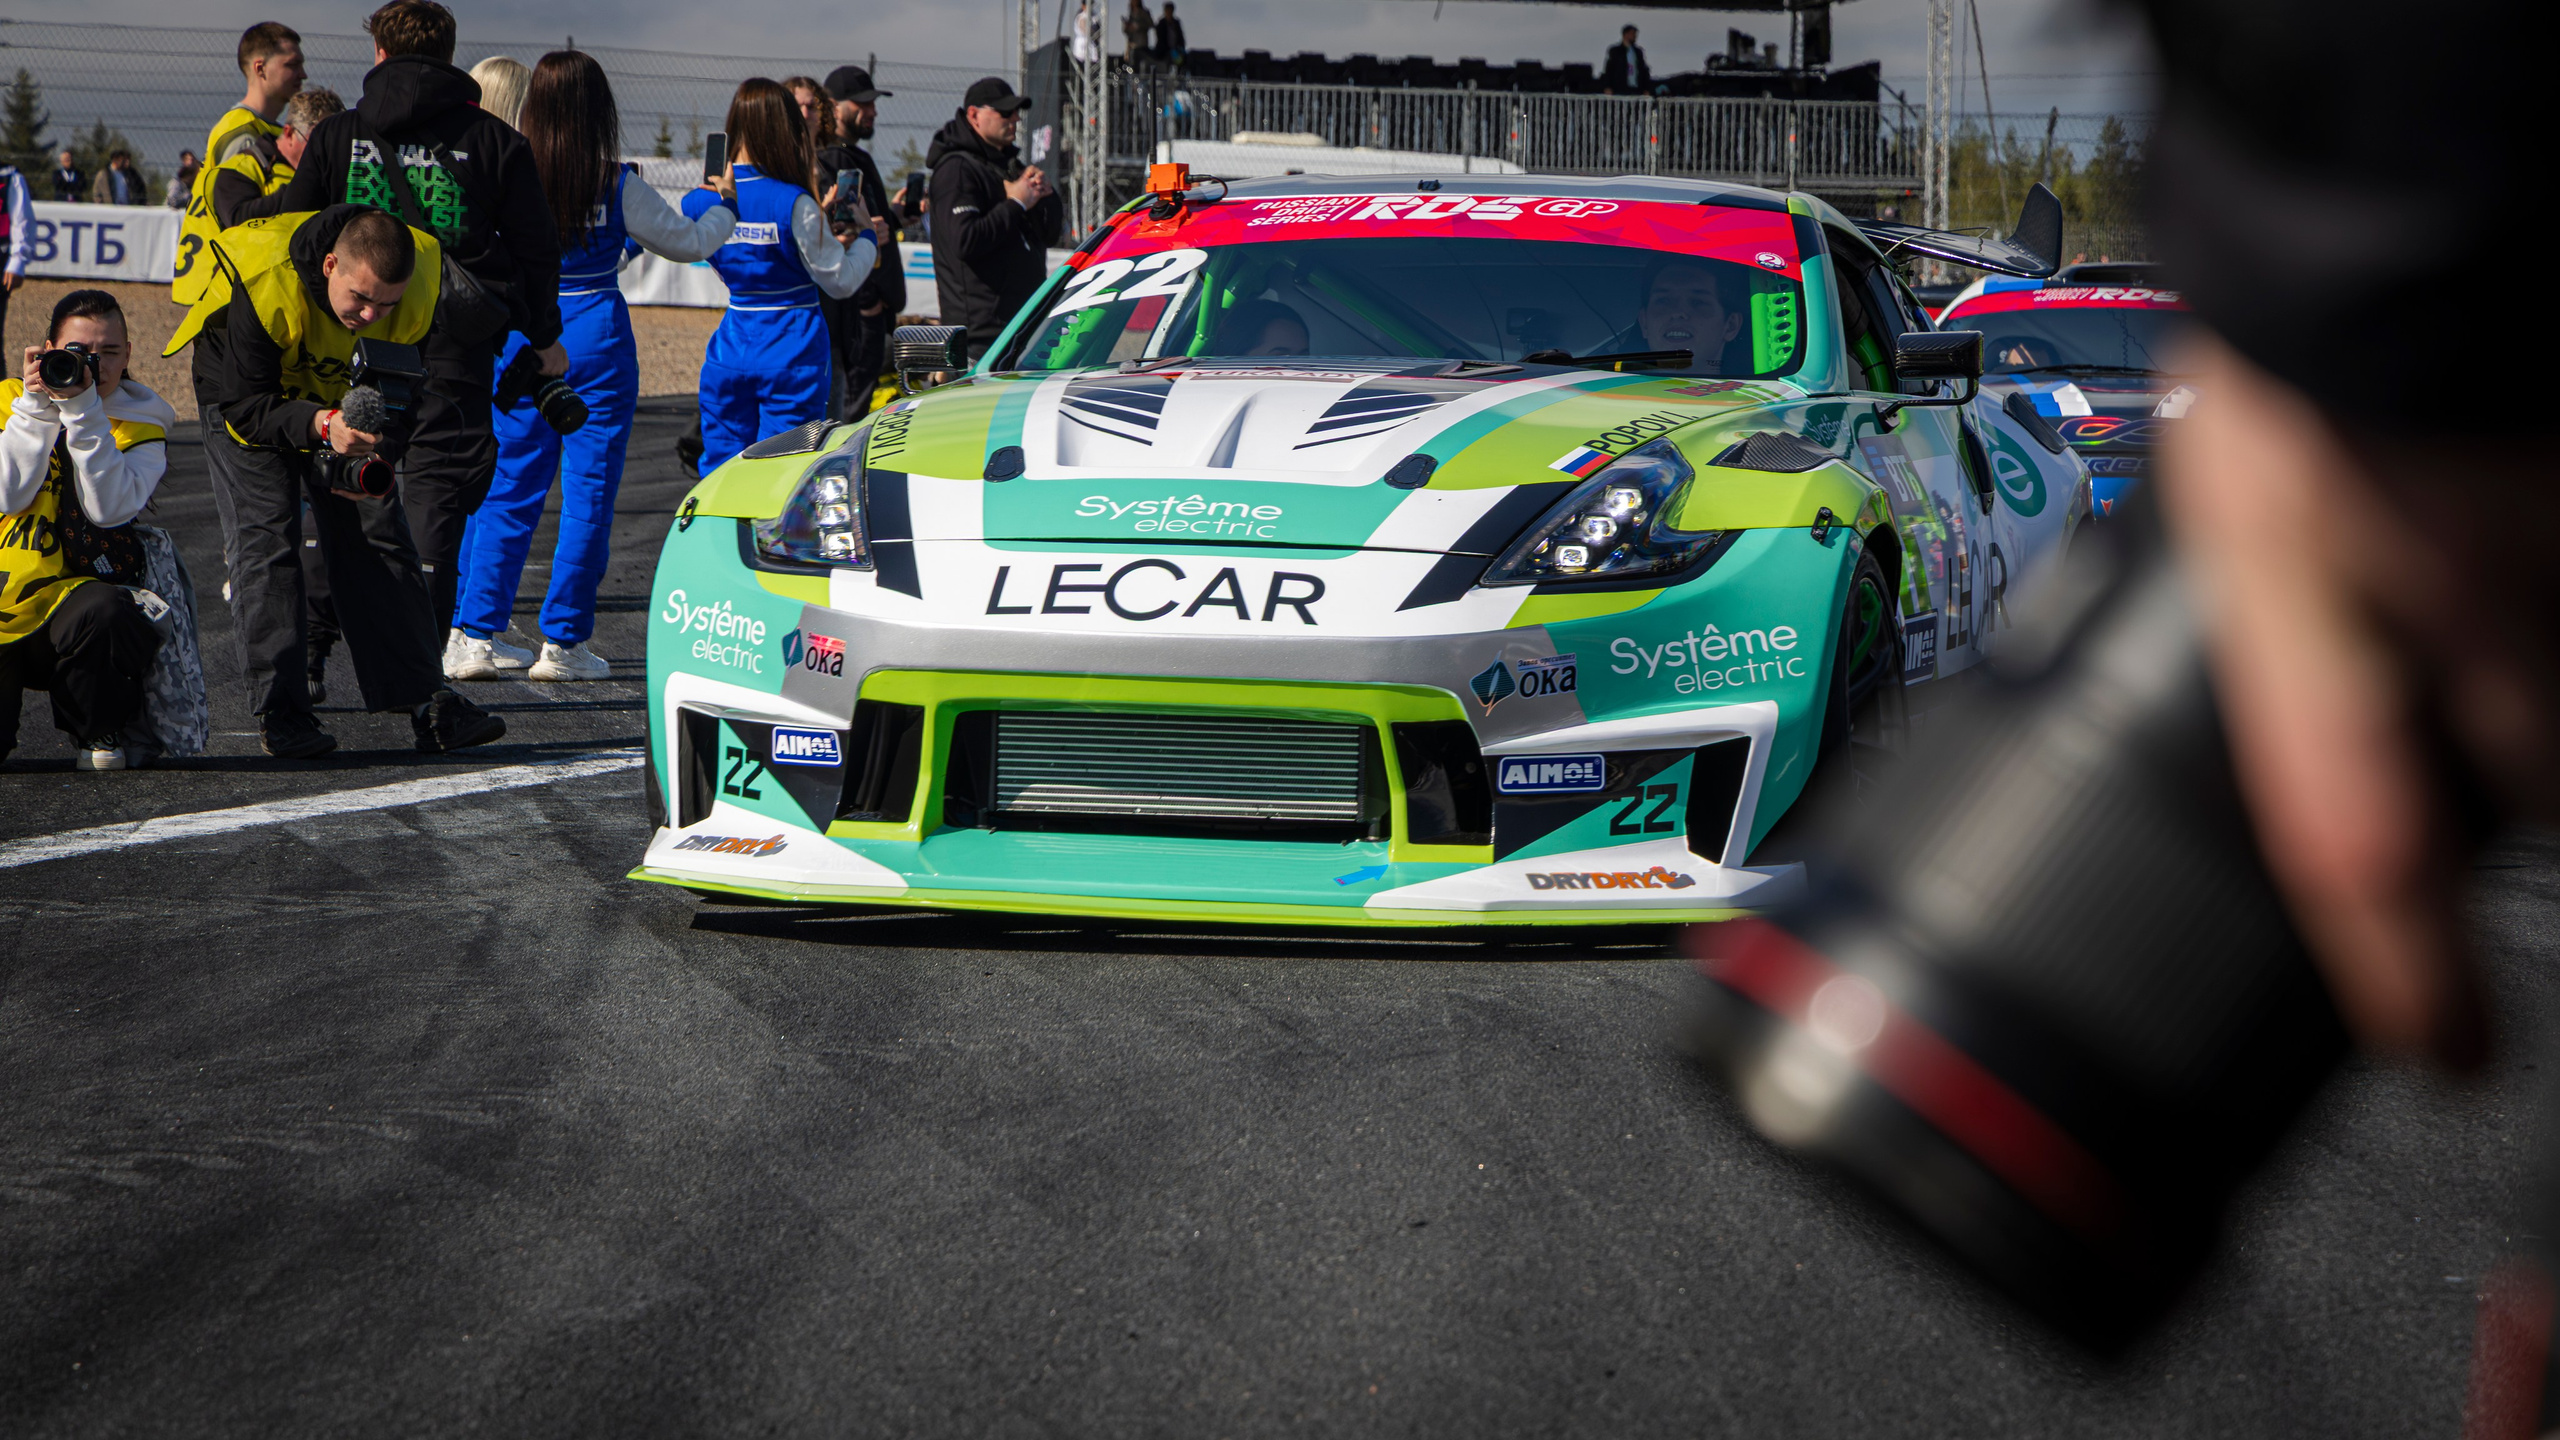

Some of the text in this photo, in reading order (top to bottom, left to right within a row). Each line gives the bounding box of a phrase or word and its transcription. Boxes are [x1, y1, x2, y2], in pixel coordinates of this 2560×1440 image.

[1246, 213, 1331, 227] SERIES
[1253, 197, 1357, 211] RUSSIAN
[1271, 204, 1346, 217] DRIFT
[1349, 195, 1619, 221] RDS GP
[34, 220, 125, 265] ВТБ
[1048, 248, 1209, 319] 22
[871, 408, 917, 449] POPOV
[1583, 411, 1680, 456] POPOV
[1075, 494, 1282, 521] Systême
[1134, 515, 1277, 538] electric
[985, 558, 1326, 626] LECAR
[662, 589, 766, 645] Systême
[692, 634, 763, 674] electric
[1610, 624, 1798, 679] Systême
[1674, 656, 1806, 694] electric
[775, 734, 838, 758] AIMOL
[723, 745, 765, 801] 22
[1503, 762, 1600, 785] AIMOL
[1610, 782, 1678, 837] 22
[673, 834, 764, 855] DRYDRY
[1526, 871, 1655, 890] DRYDRY
